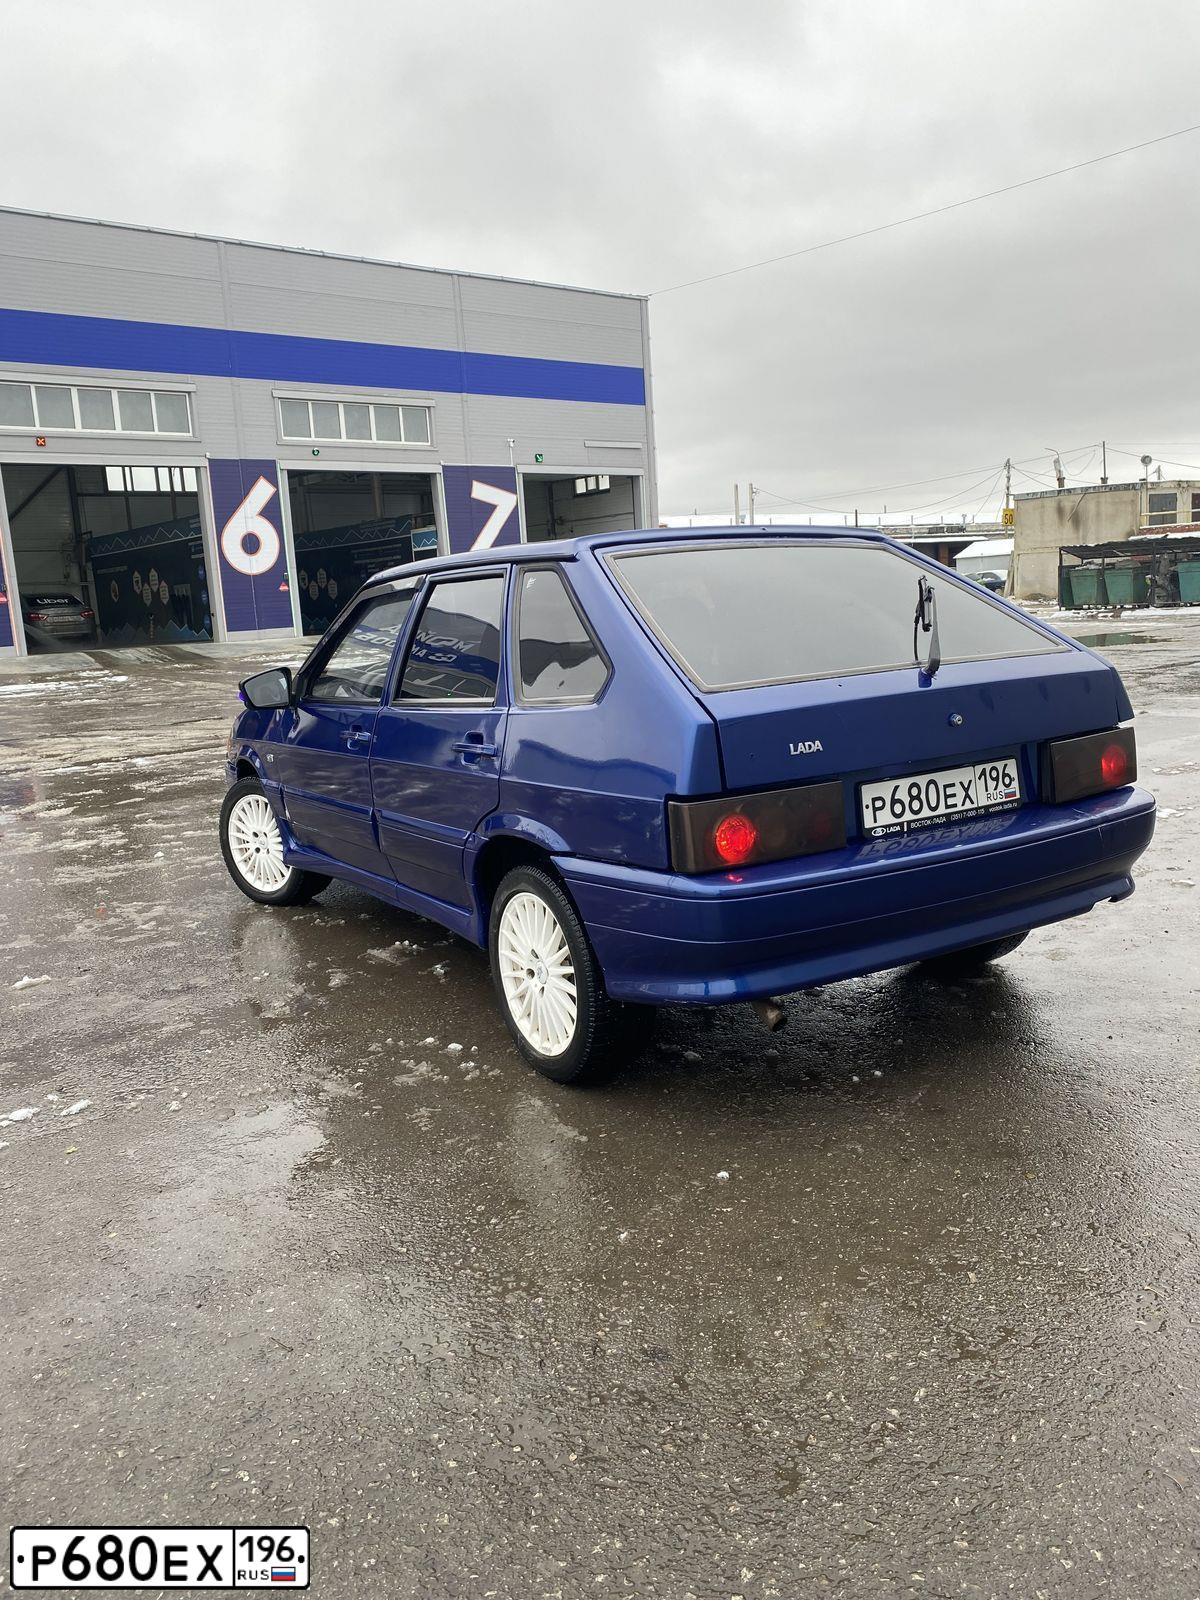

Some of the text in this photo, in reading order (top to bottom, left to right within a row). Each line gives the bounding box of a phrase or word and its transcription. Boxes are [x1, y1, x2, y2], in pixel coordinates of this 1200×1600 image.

[470, 480, 518, 552] 7
[1004, 513, 1014, 525] 50
[221, 475, 280, 576] 6
[36, 597, 69, 605] Uber
[789, 740, 823, 755] LADA
[978, 763, 1012, 793] 196
[986, 790, 1004, 802] RUS
[910, 816, 947, 828] ВОСТОК-ЛАДА
[887, 825, 901, 833] LADA
